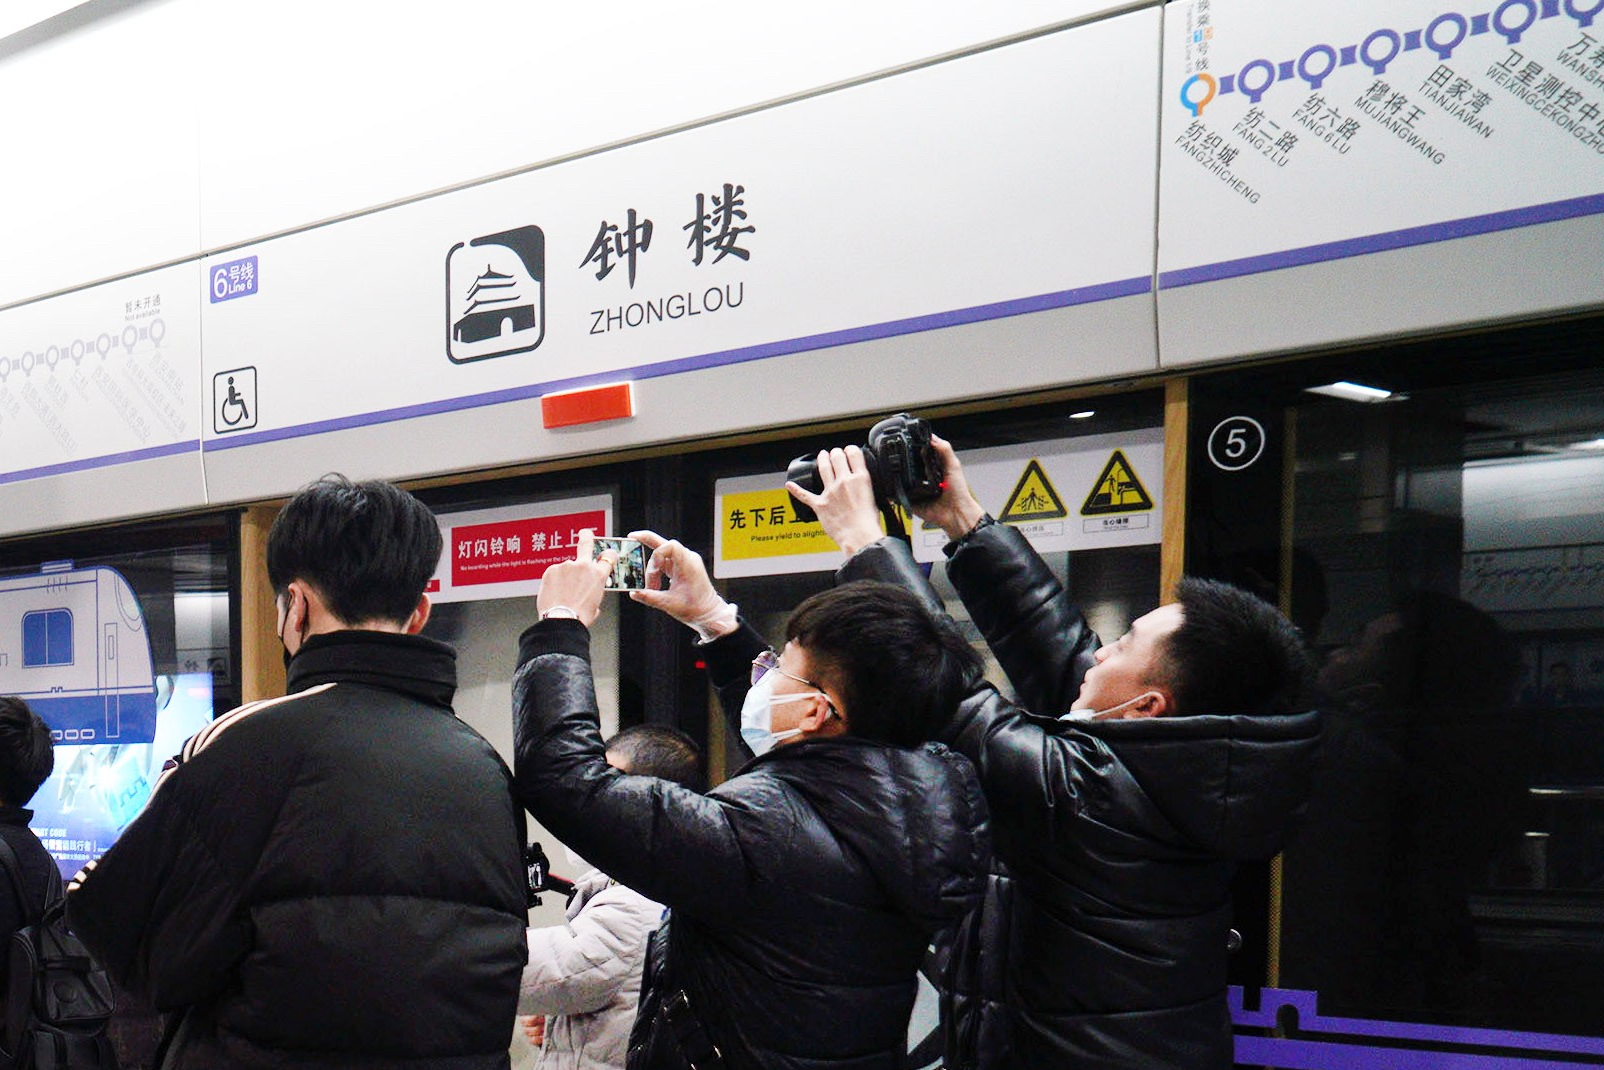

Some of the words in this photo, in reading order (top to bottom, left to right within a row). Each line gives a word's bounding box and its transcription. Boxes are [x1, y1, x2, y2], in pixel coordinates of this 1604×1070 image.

[1366, 79, 1426, 129] 穆将王
[1418, 81, 1495, 140] TIANJIAWAN
[1429, 64, 1495, 115] 田家湾
[1242, 106, 1300, 155] 纺二路
[1292, 109, 1325, 138] FANG
[1332, 139, 1352, 155] LU
[1303, 92, 1361, 142] 纺六路
[1354, 96, 1446, 166] MUJIANGWANG
[1185, 120, 1240, 166] 纺织城
[1232, 123, 1264, 149] FANG
[1271, 151, 1291, 168] LU
[1174, 135, 1262, 205] FANGZHICHENG
[578, 183, 757, 291] 钟楼
[228, 281, 246, 294] Line
[246, 279, 253, 290] 6
[589, 281, 745, 336] ZHONGLOU
[1224, 428, 1247, 458] 5
[457, 535, 522, 560] 灯闪铃响
[530, 527, 598, 552] 禁止上
[750, 534, 775, 543] Please
[775, 533, 793, 543] yield
[793, 531, 801, 539] to
